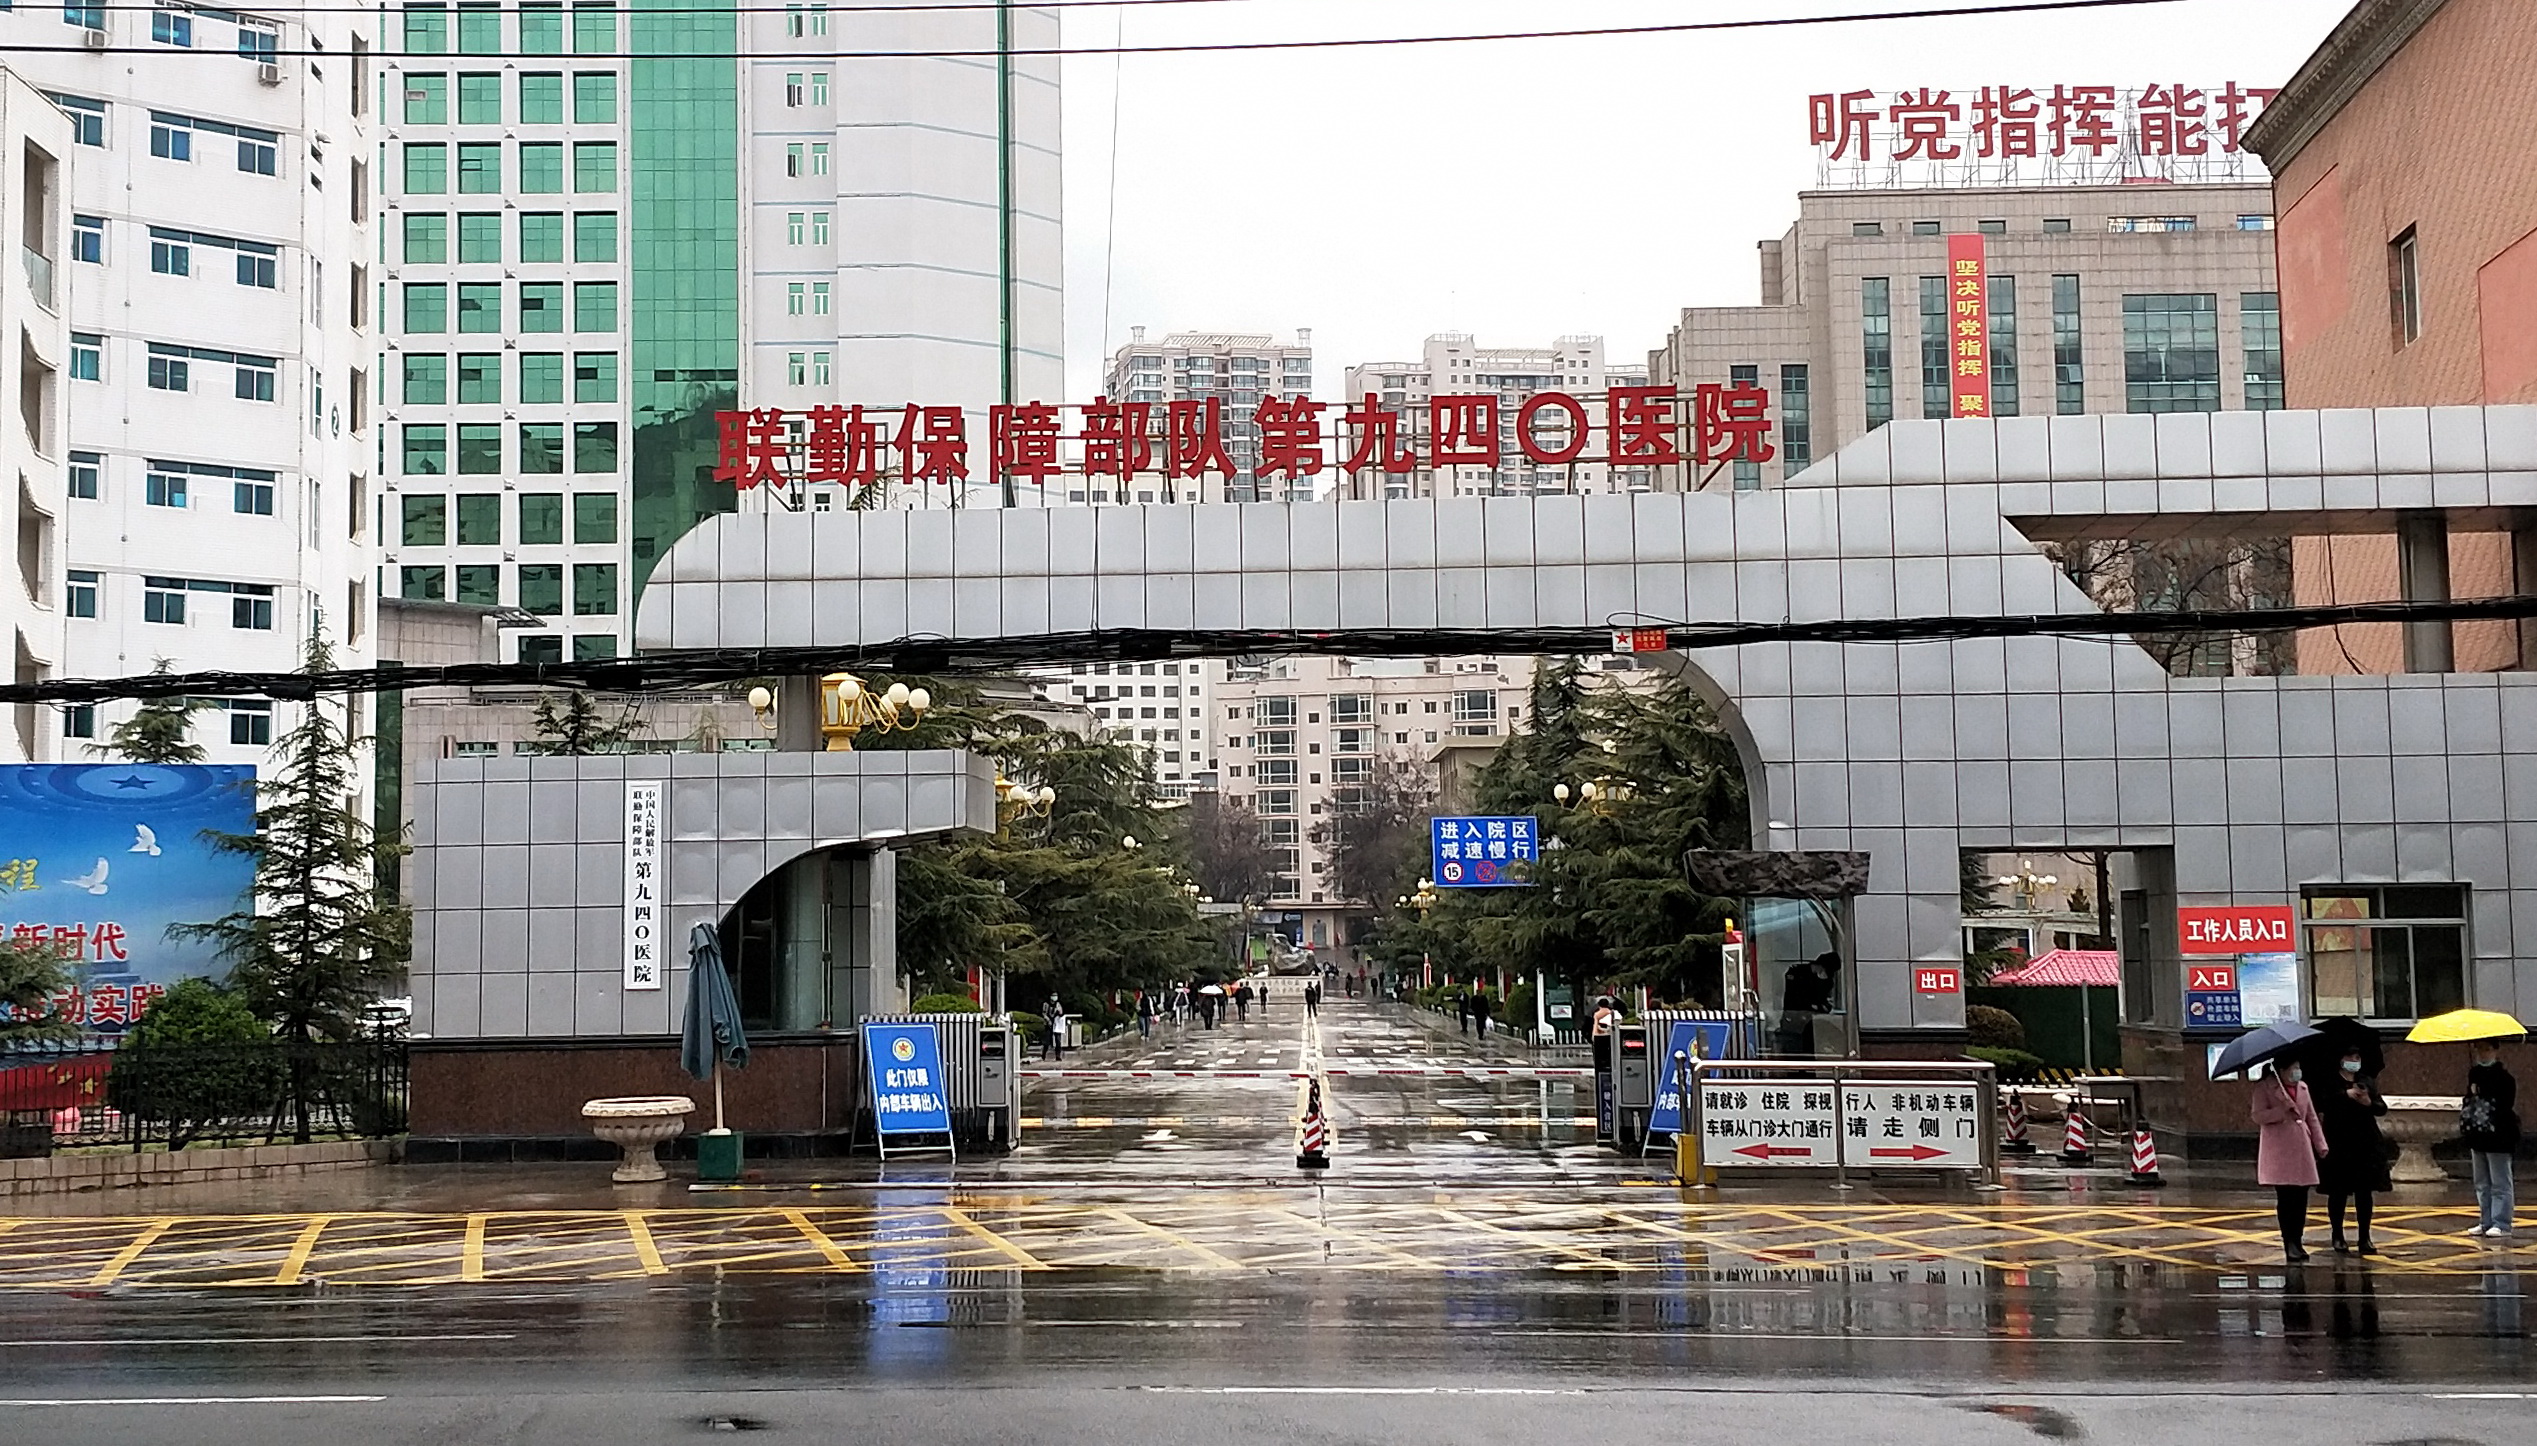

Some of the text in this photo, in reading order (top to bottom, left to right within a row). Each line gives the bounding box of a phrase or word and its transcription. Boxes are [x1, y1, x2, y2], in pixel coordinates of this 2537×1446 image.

[1441, 821, 1530, 839] 进入院区
[1441, 841, 1531, 859] 减速慢行
[1446, 866, 1459, 878] 15
[2187, 918, 2287, 942] 工作人员入口
[1921, 972, 1955, 989] 出口
[2193, 970, 2228, 987] 入口
[879, 1092, 943, 1114] 内部车辆出入
[1705, 1092, 1833, 1110] 请就诊 住院 探视
[1846, 1093, 1974, 1112] 行人 非机动车辆
[1706, 1119, 1833, 1138] 车辆从门诊大门通行
[1847, 1117, 1975, 1138] 请走侧门
